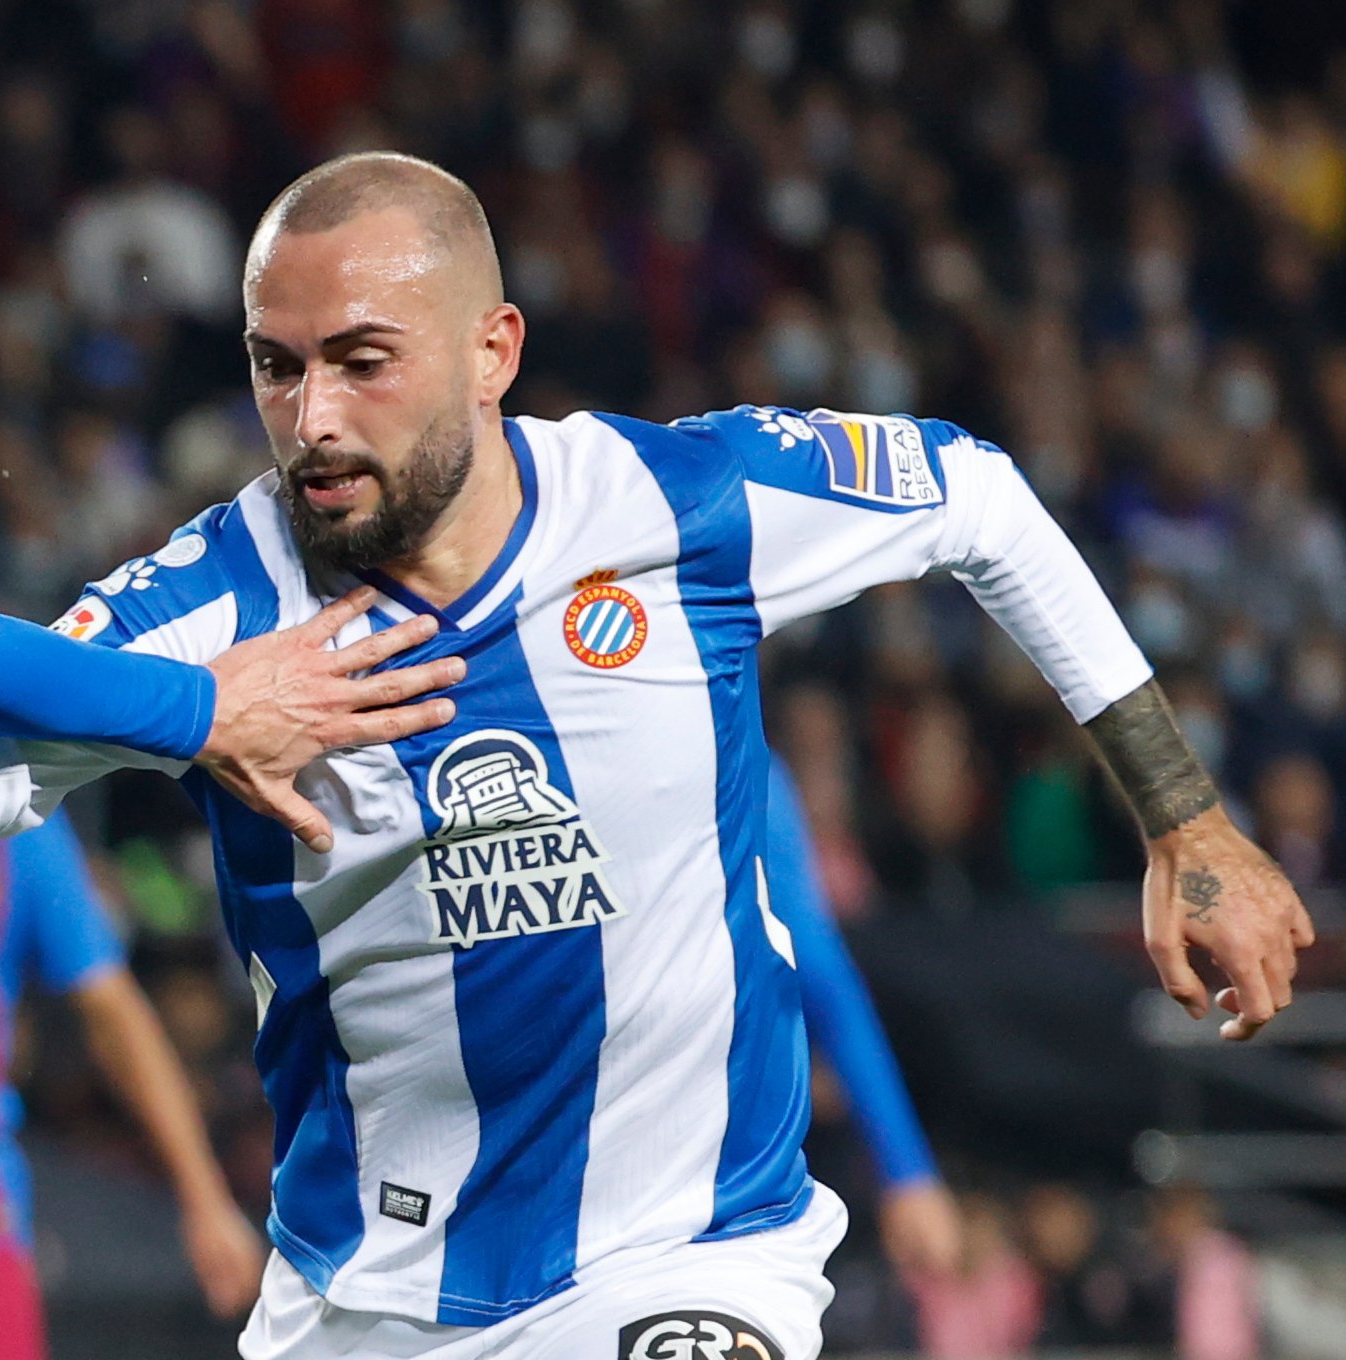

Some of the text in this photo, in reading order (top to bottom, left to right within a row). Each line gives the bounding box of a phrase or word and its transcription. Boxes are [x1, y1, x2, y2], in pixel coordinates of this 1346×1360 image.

[565, 587, 641, 631] RCD ESPANYOL
[570, 621, 646, 666] DE BARCELONA
[423, 828, 600, 882] RIVIERA
[428, 872, 617, 940] MAYA
